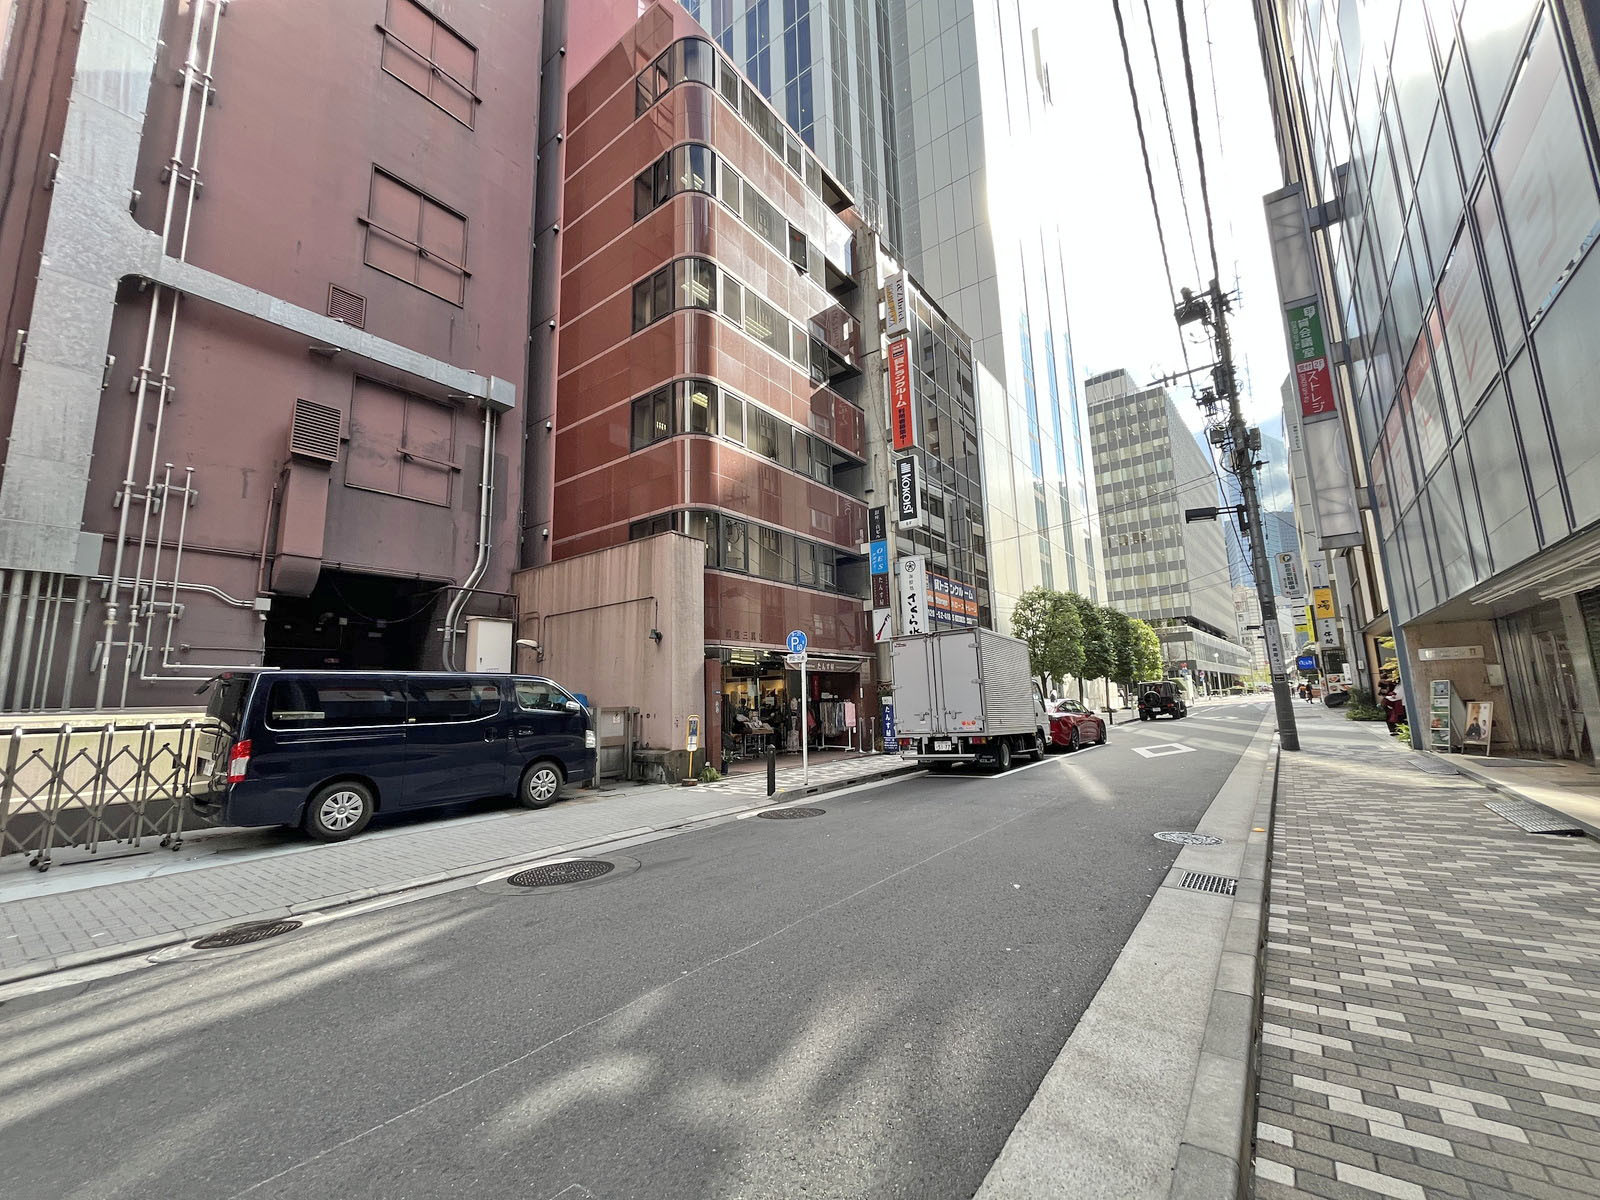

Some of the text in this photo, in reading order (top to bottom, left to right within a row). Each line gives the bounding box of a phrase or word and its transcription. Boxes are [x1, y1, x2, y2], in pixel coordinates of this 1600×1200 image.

[1307, 369, 1325, 413] ストレジ
[901, 473, 914, 514] KOKOIST
[790, 636, 799, 651] P
[884, 706, 892, 737] たんす屋
